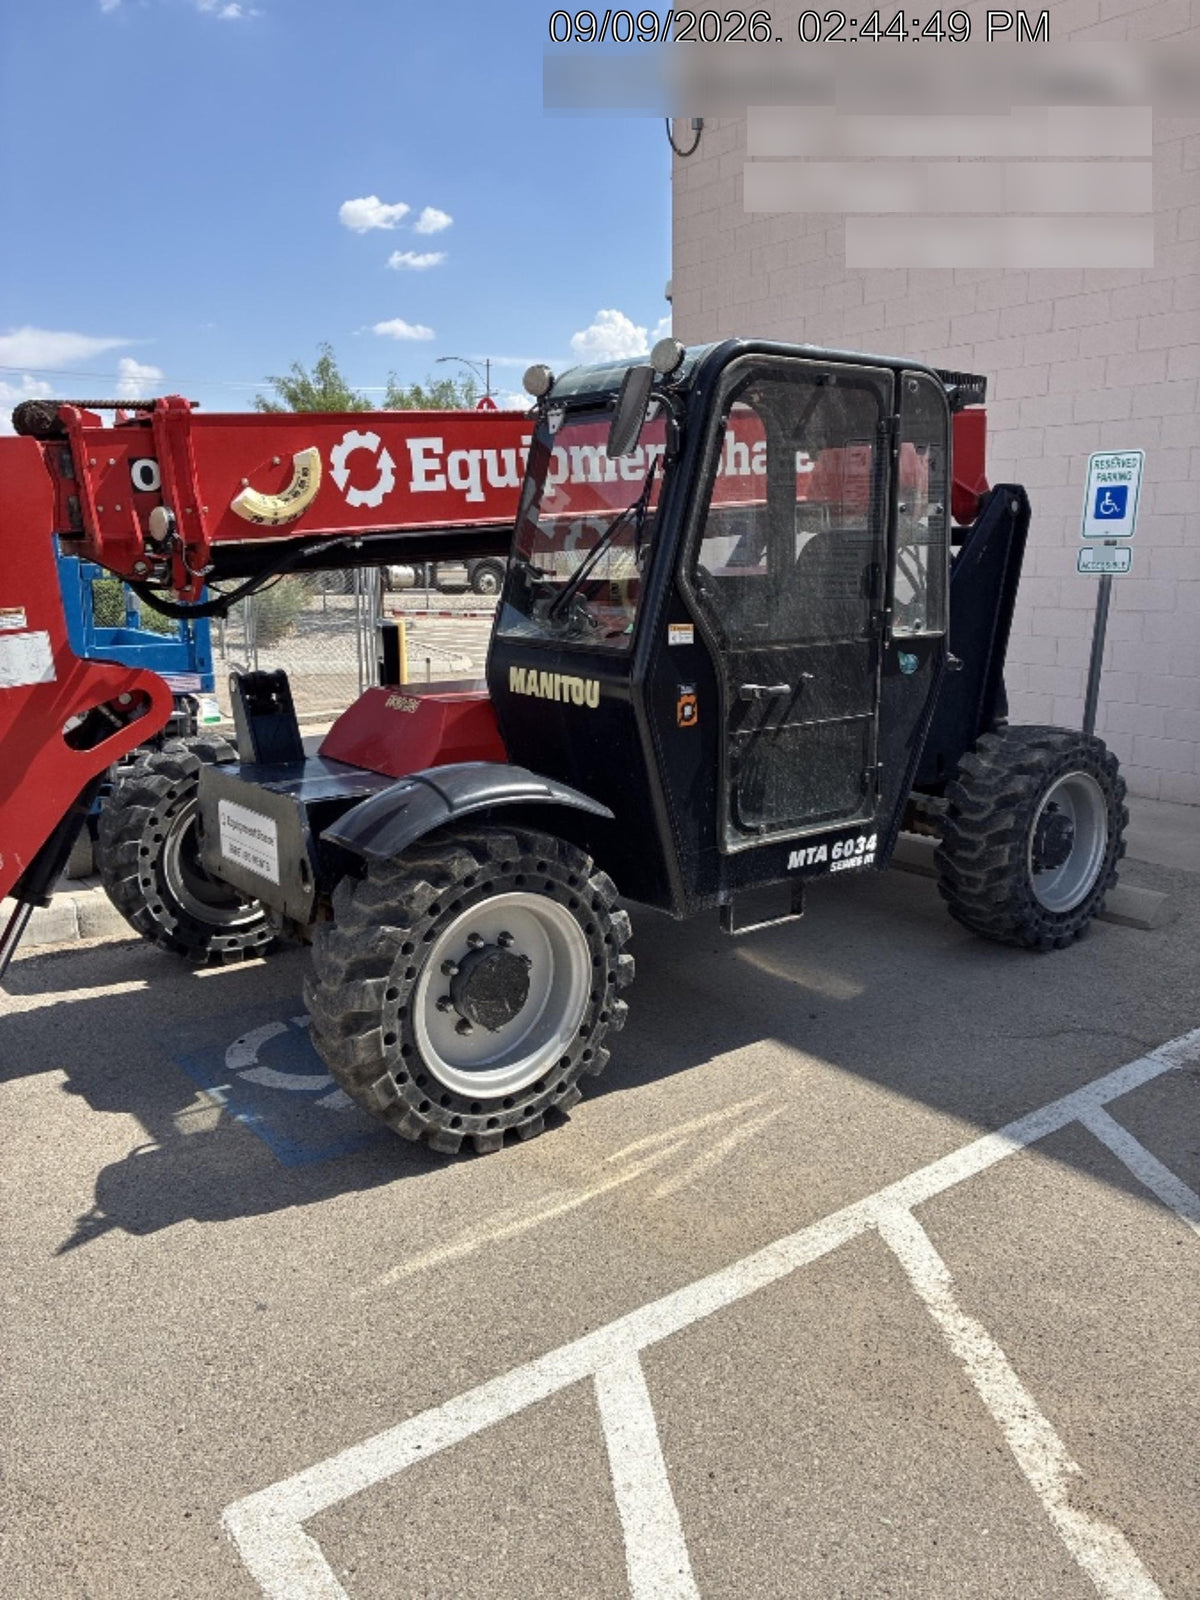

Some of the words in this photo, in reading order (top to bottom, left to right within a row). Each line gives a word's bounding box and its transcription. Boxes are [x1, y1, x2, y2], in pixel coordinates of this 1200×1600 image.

[1094, 457, 1137, 470] RESERVED
[1096, 471, 1132, 482] PARKING
[509, 666, 600, 708] MANITOU
[787, 844, 828, 870] MTA
[831, 833, 877, 860] 6034
